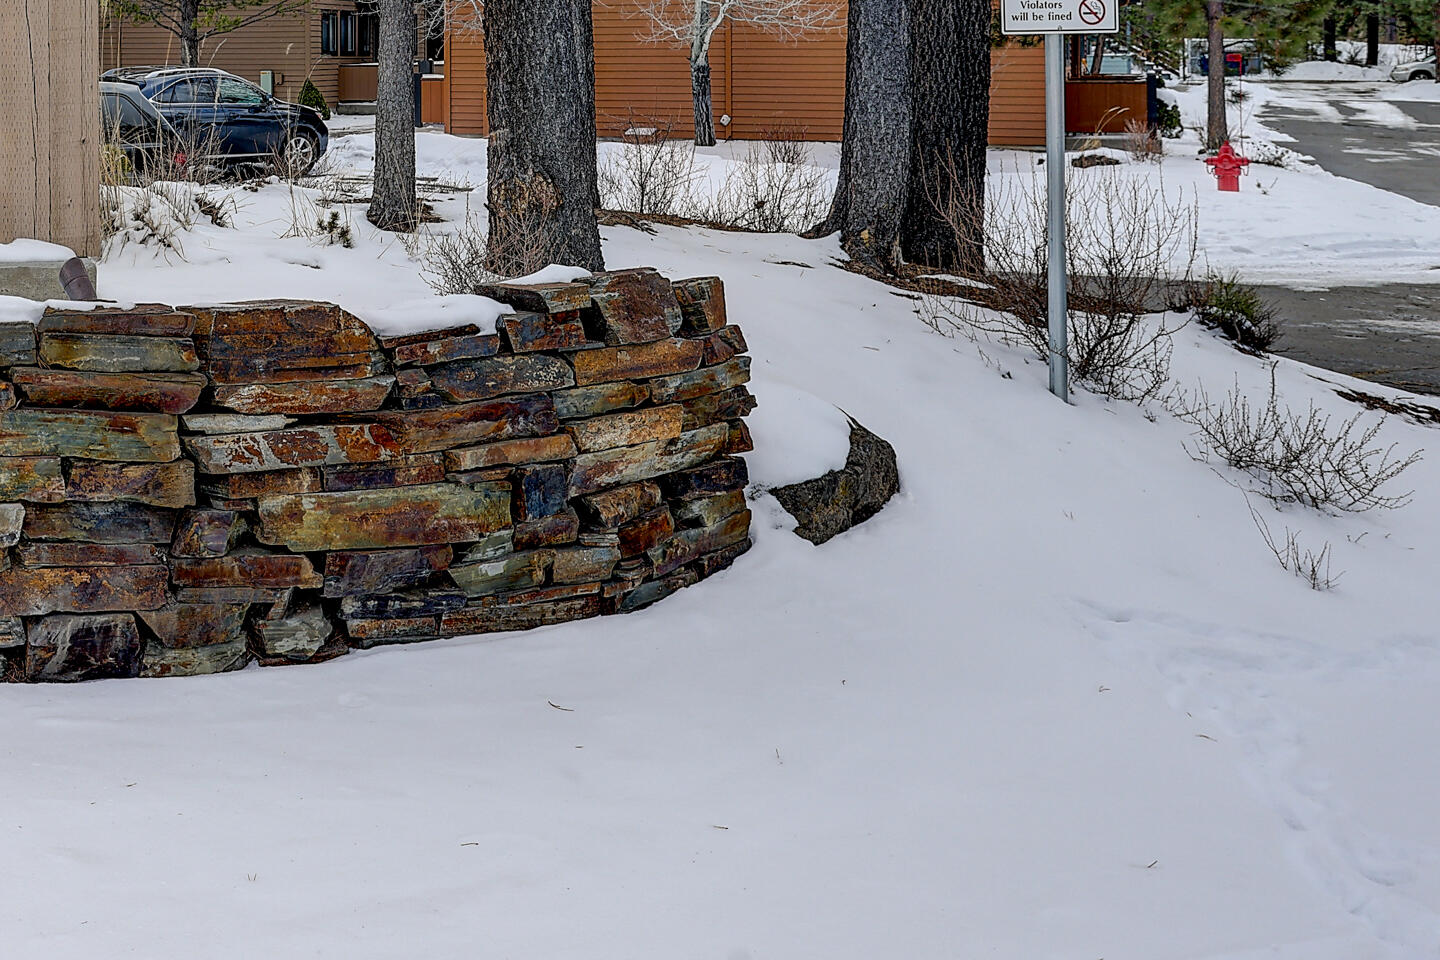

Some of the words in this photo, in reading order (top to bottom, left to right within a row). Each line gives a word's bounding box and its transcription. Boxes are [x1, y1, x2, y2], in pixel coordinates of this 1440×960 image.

[1020, 0, 1063, 9] Violators
[1011, 12, 1028, 21] will
[1032, 12, 1044, 21] be
[1048, 11, 1072, 21] fined
